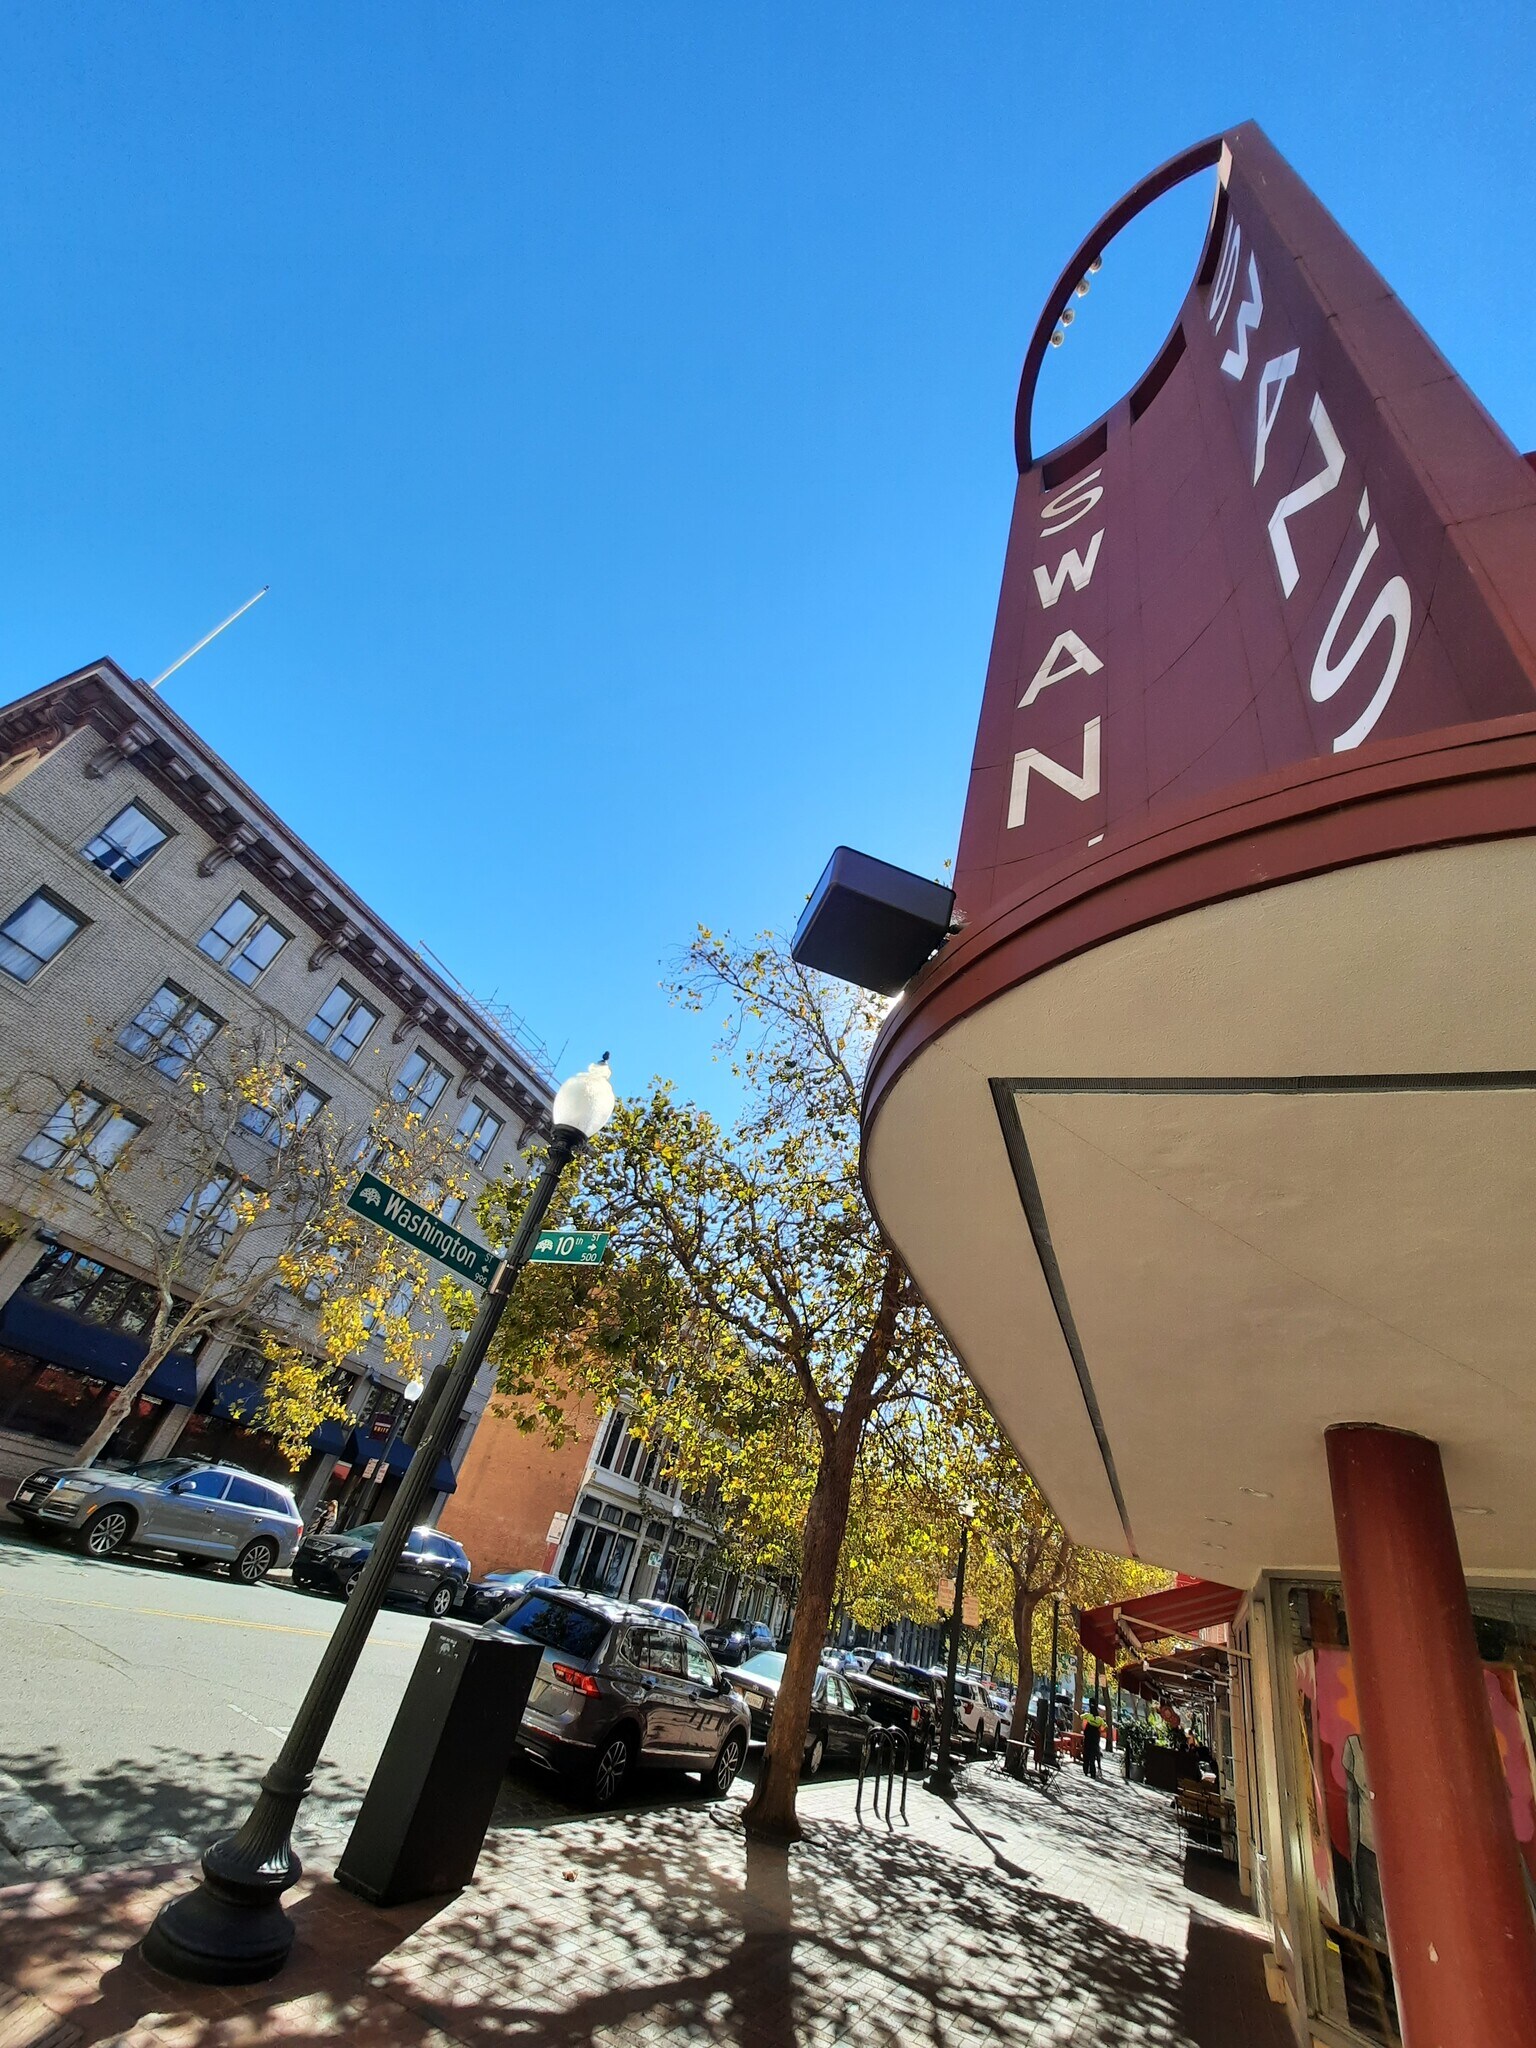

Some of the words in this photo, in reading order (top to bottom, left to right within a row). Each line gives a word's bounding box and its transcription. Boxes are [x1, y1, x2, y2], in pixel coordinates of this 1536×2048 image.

[1209, 214, 1412, 754] SWAN'S
[383, 1193, 477, 1269] Washington
[484, 1252, 494, 1264] ST
[555, 1236, 584, 1256] 10th
[591, 1233, 601, 1242] ST
[580, 1252, 598, 1262] 500
[474, 1272, 488, 1286] 999
